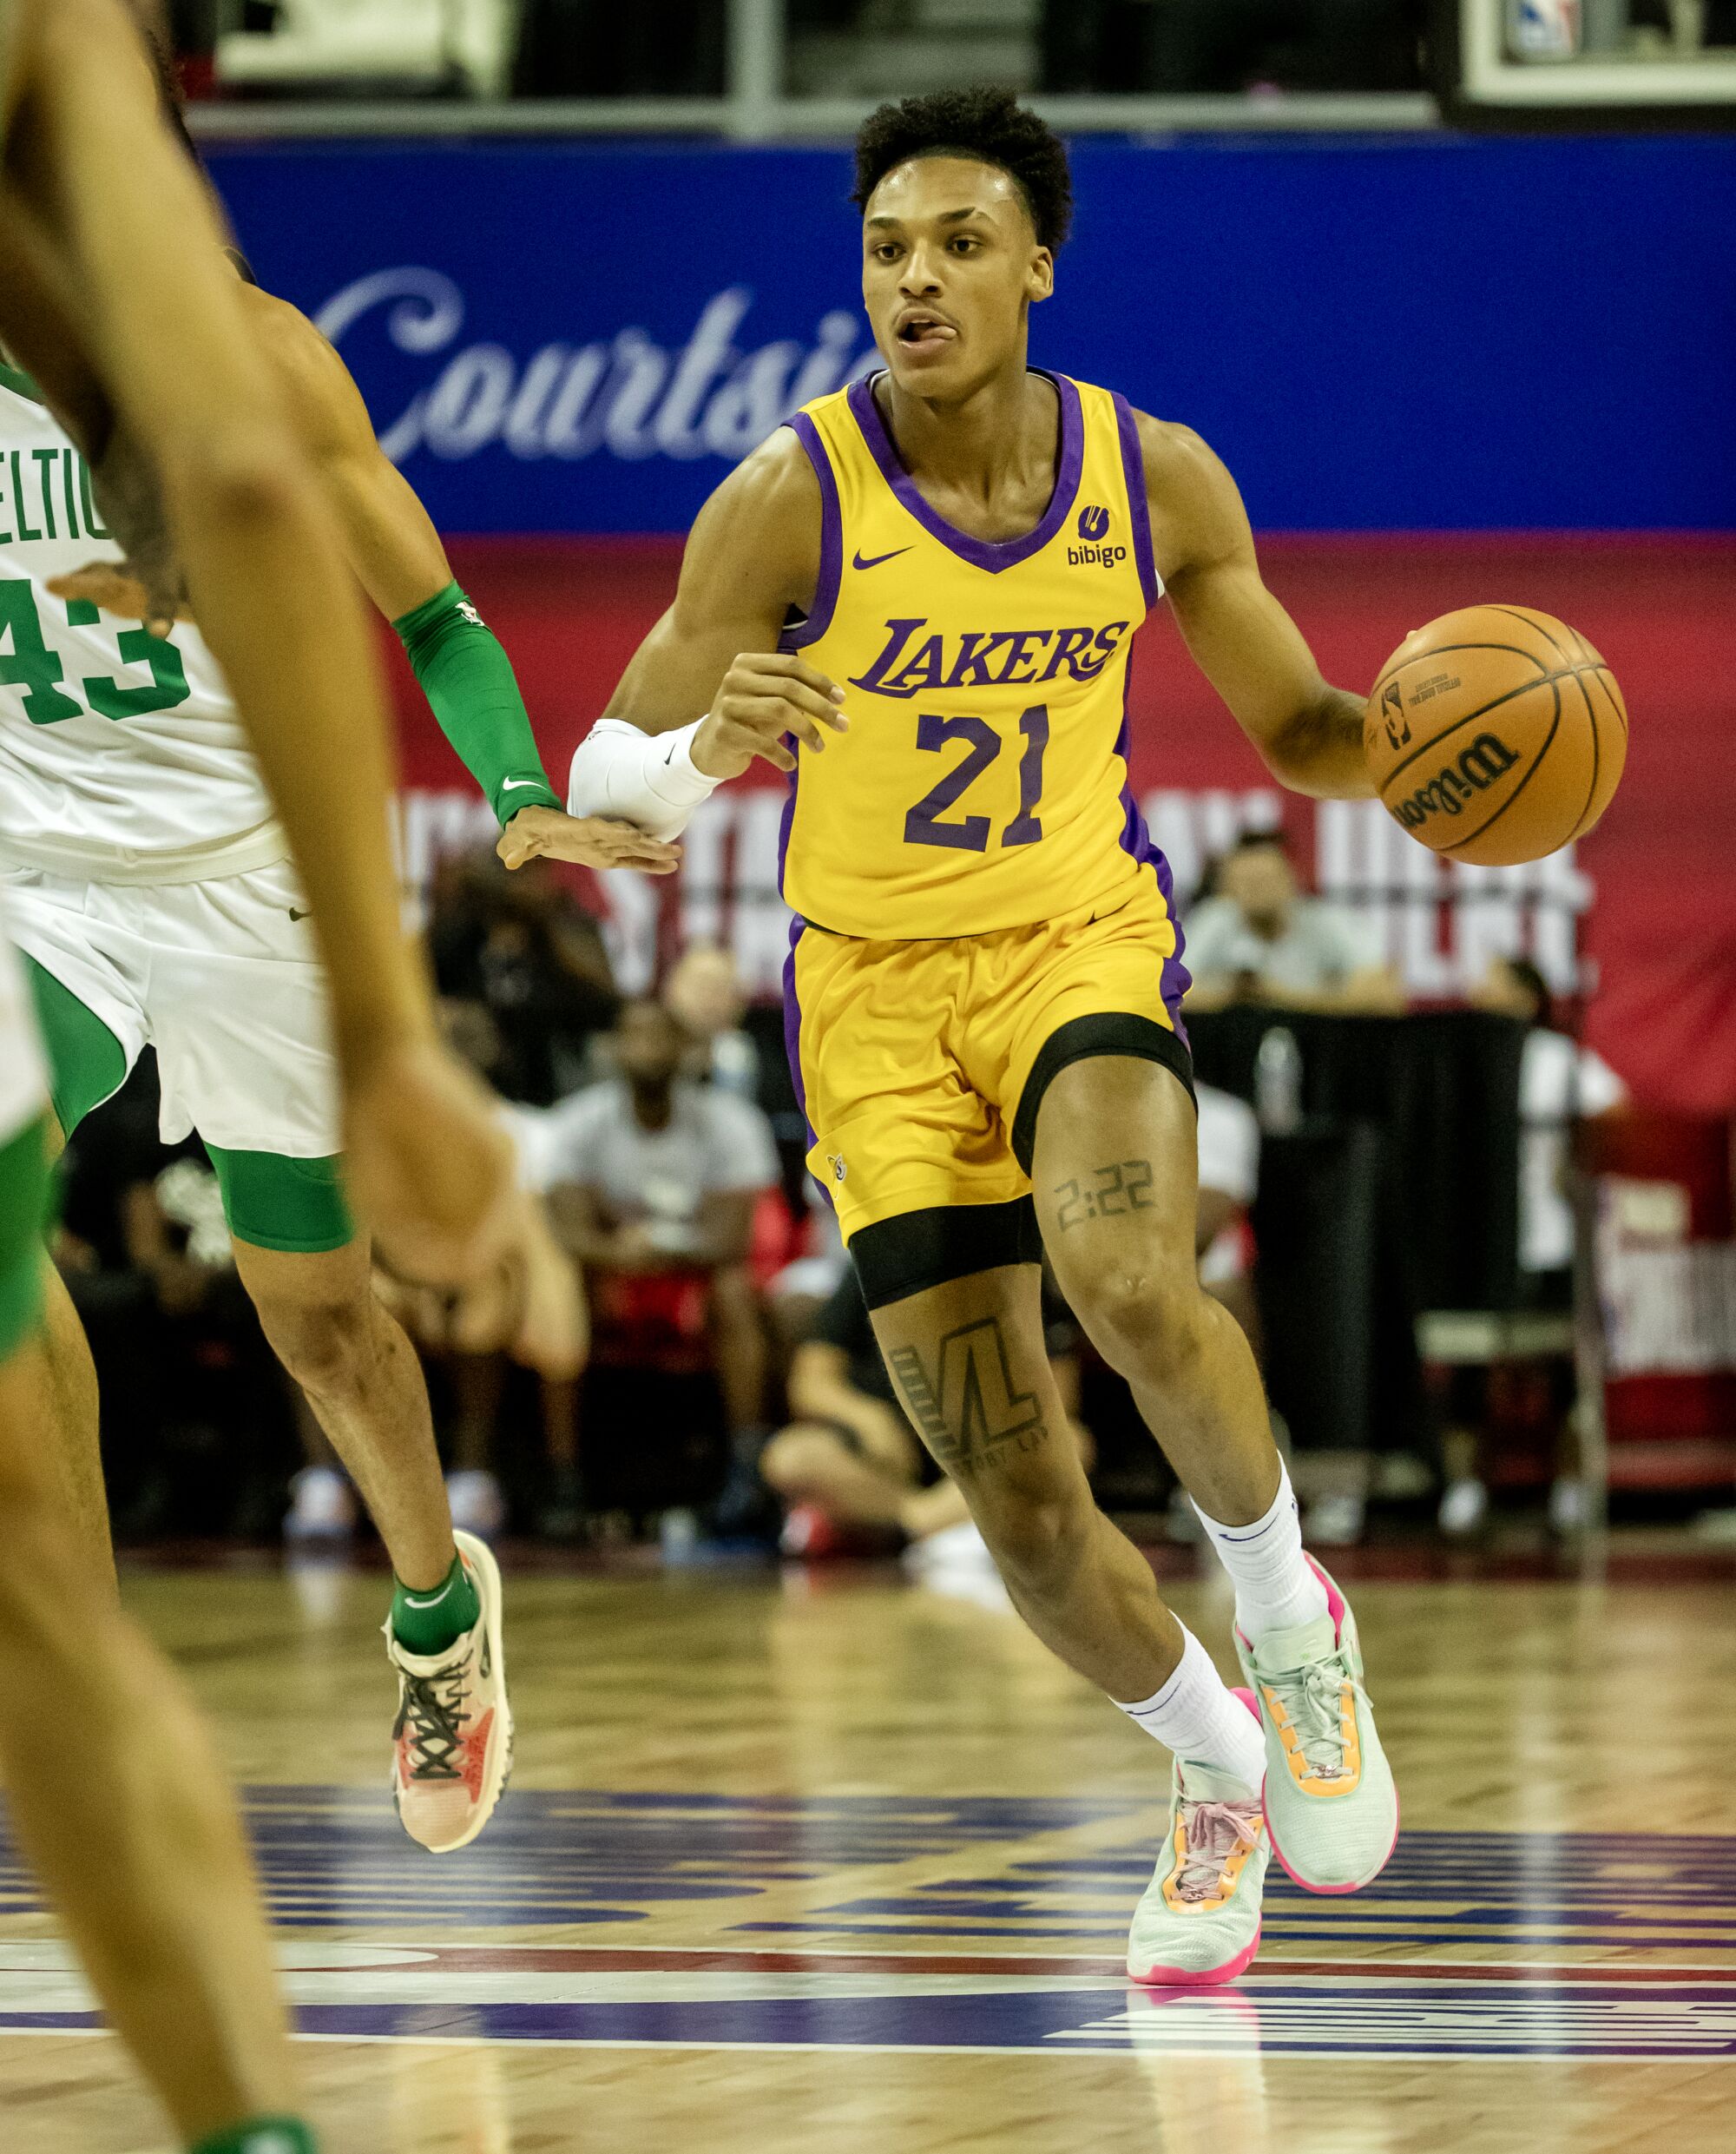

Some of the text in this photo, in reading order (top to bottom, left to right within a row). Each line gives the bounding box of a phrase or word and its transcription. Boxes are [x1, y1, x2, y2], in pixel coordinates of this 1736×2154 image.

[312, 266, 886, 463] Courtsi
[1068, 543, 1126, 568] bibigo
[0, 578, 191, 725] 43
[847, 618, 1130, 699] LAKERS
[904, 703, 1049, 853] 21
[1393, 732, 1522, 828] Wilson
[1054, 1160, 1155, 1233] 2:22
